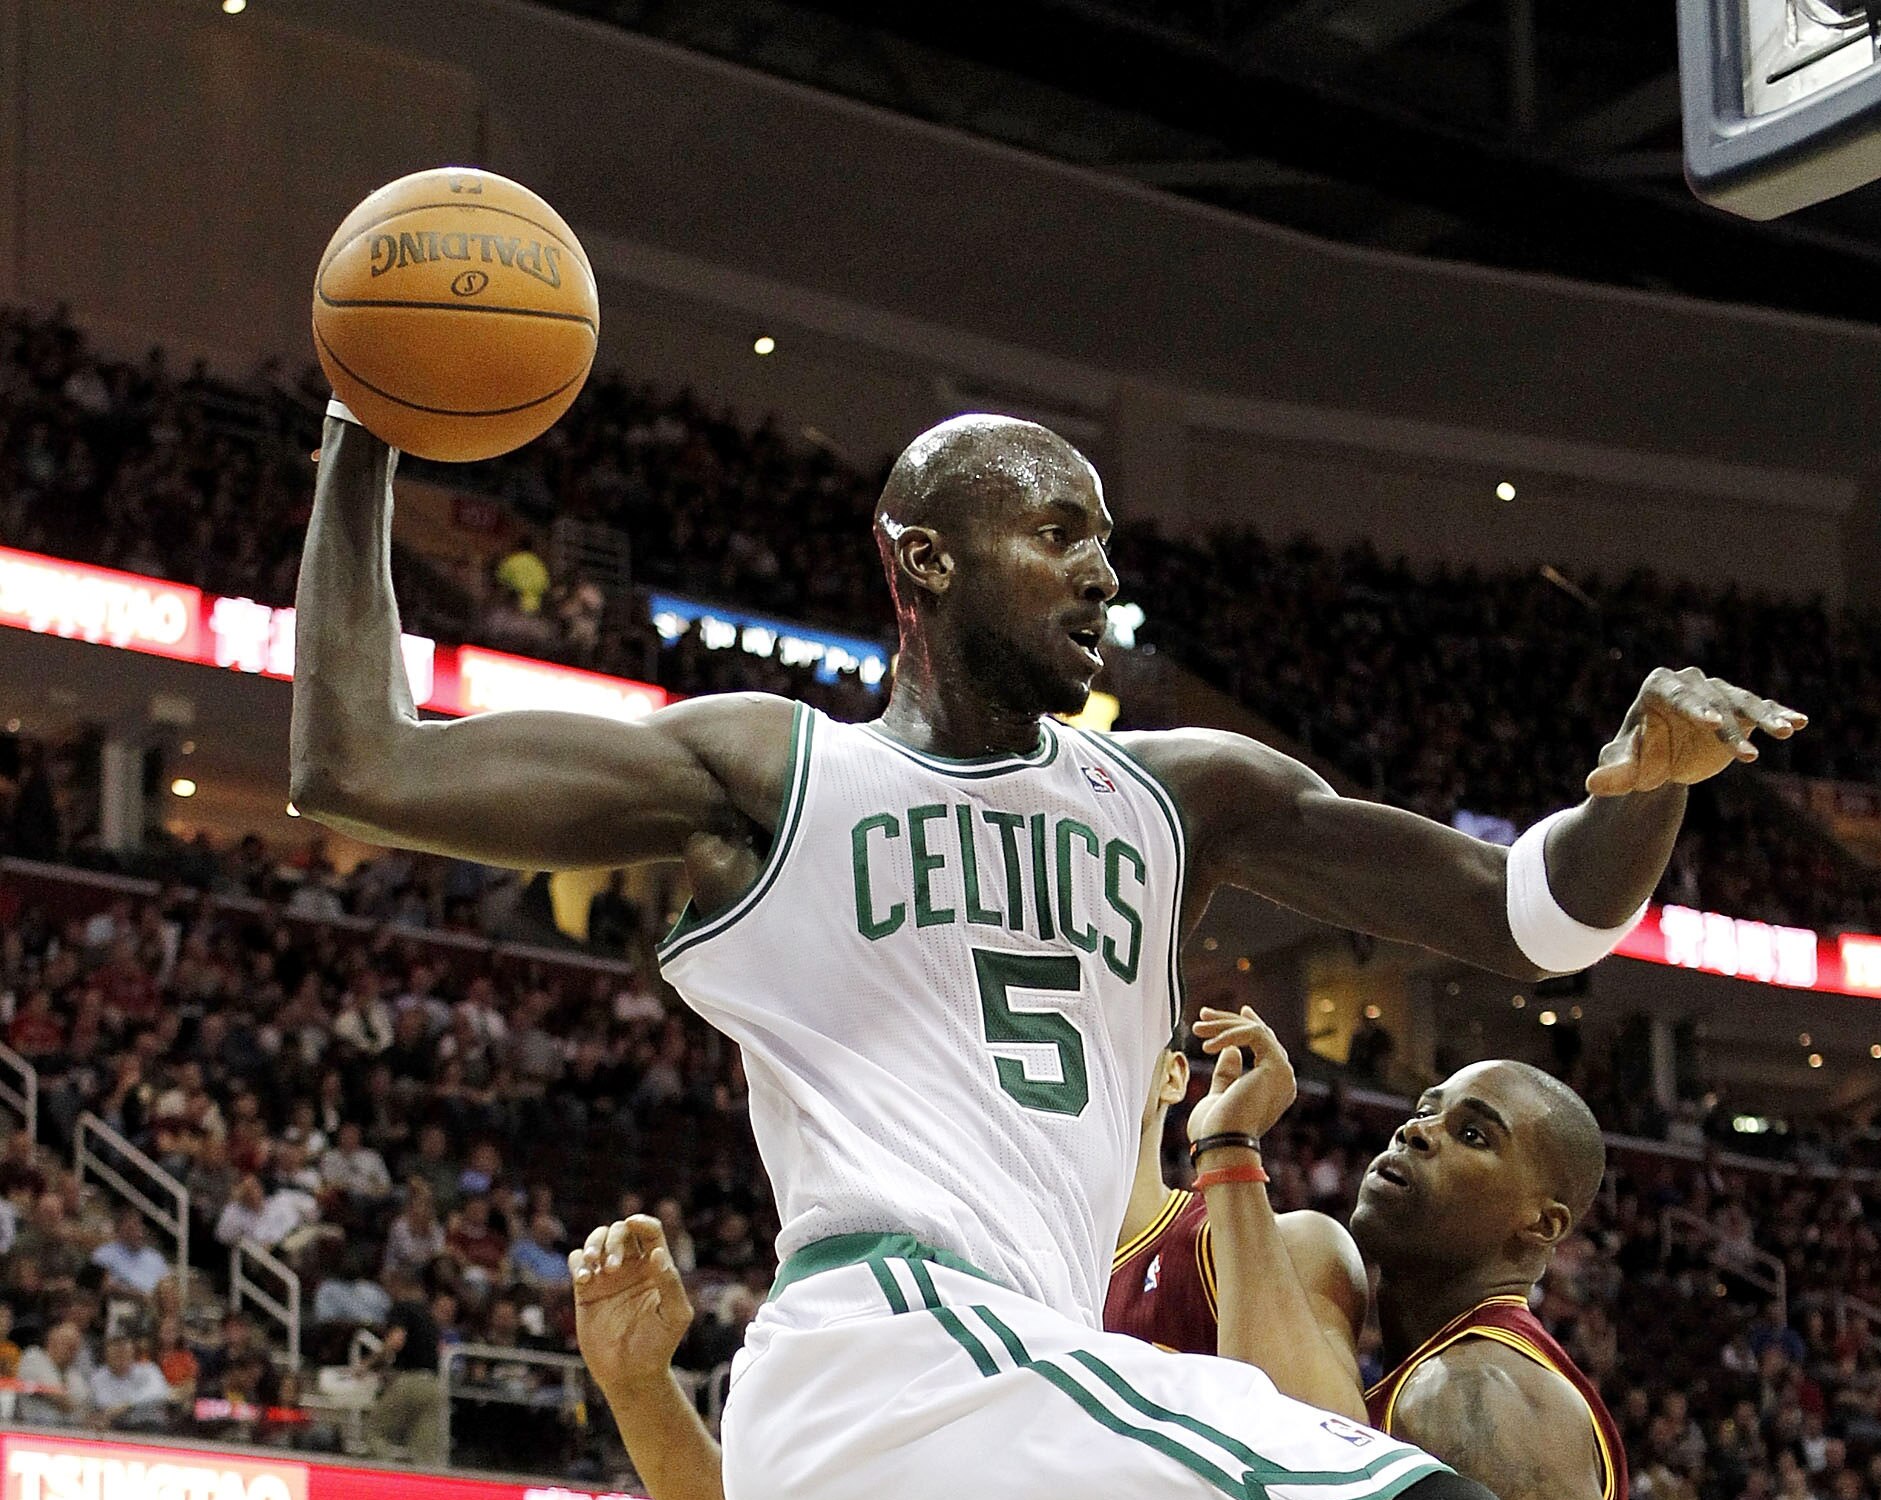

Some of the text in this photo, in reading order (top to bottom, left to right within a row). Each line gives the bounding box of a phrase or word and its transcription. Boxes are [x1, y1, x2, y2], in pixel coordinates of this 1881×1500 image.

[368, 231, 561, 289] SPALDING
[851, 803, 1146, 985] CELTICS
[971, 947, 1090, 1117] 5
